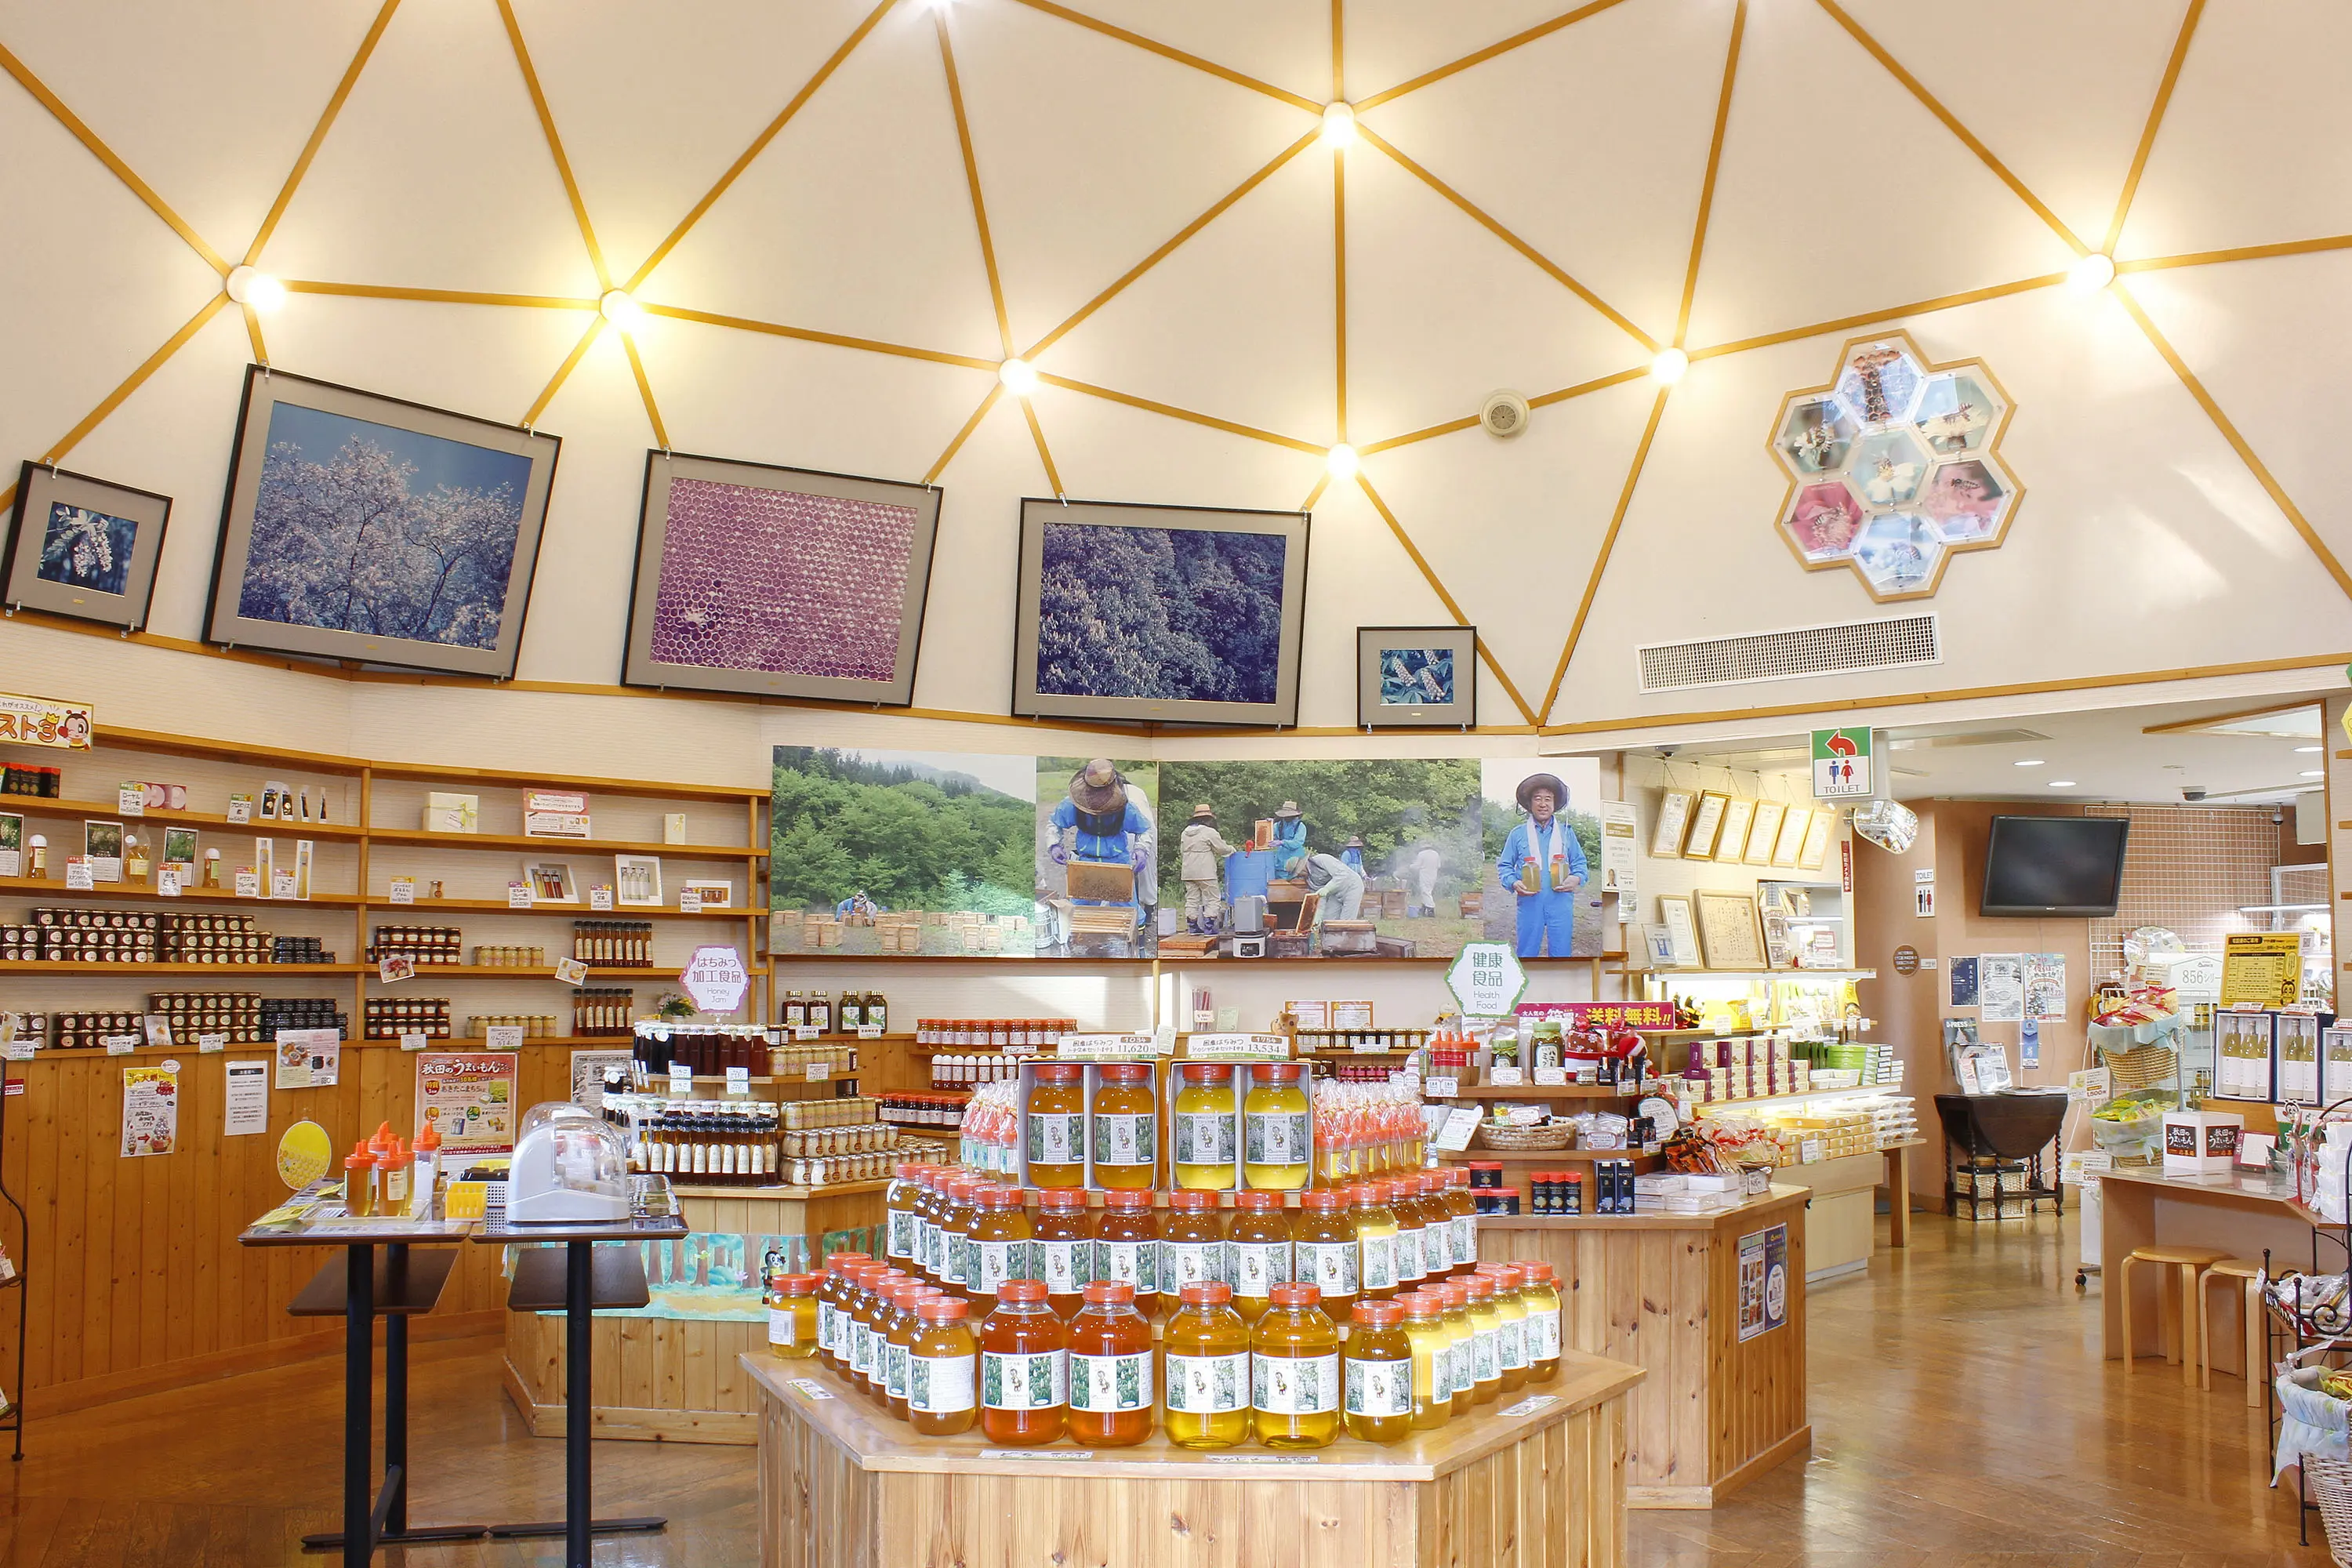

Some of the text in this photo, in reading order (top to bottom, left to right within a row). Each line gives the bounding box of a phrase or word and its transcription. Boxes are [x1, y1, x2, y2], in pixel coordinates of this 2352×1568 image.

[1824, 784, 1860, 794] TOILET
[1916, 871, 1933, 880] TOILET
[697, 956, 737, 967] はちみつ
[1472, 952, 1503, 968] 健康
[692, 970, 742, 984] 加工食品
[1472, 971, 1503, 986] 食品
[706, 987, 730, 996] Honey
[421, 1058, 499, 1076] 秋田のうまいもん
[2171, 1127, 2190, 1136] 秋田の
[2213, 1128, 2234, 1137] 秋田の
[2168, 1133, 2194, 1146] うまいもん
